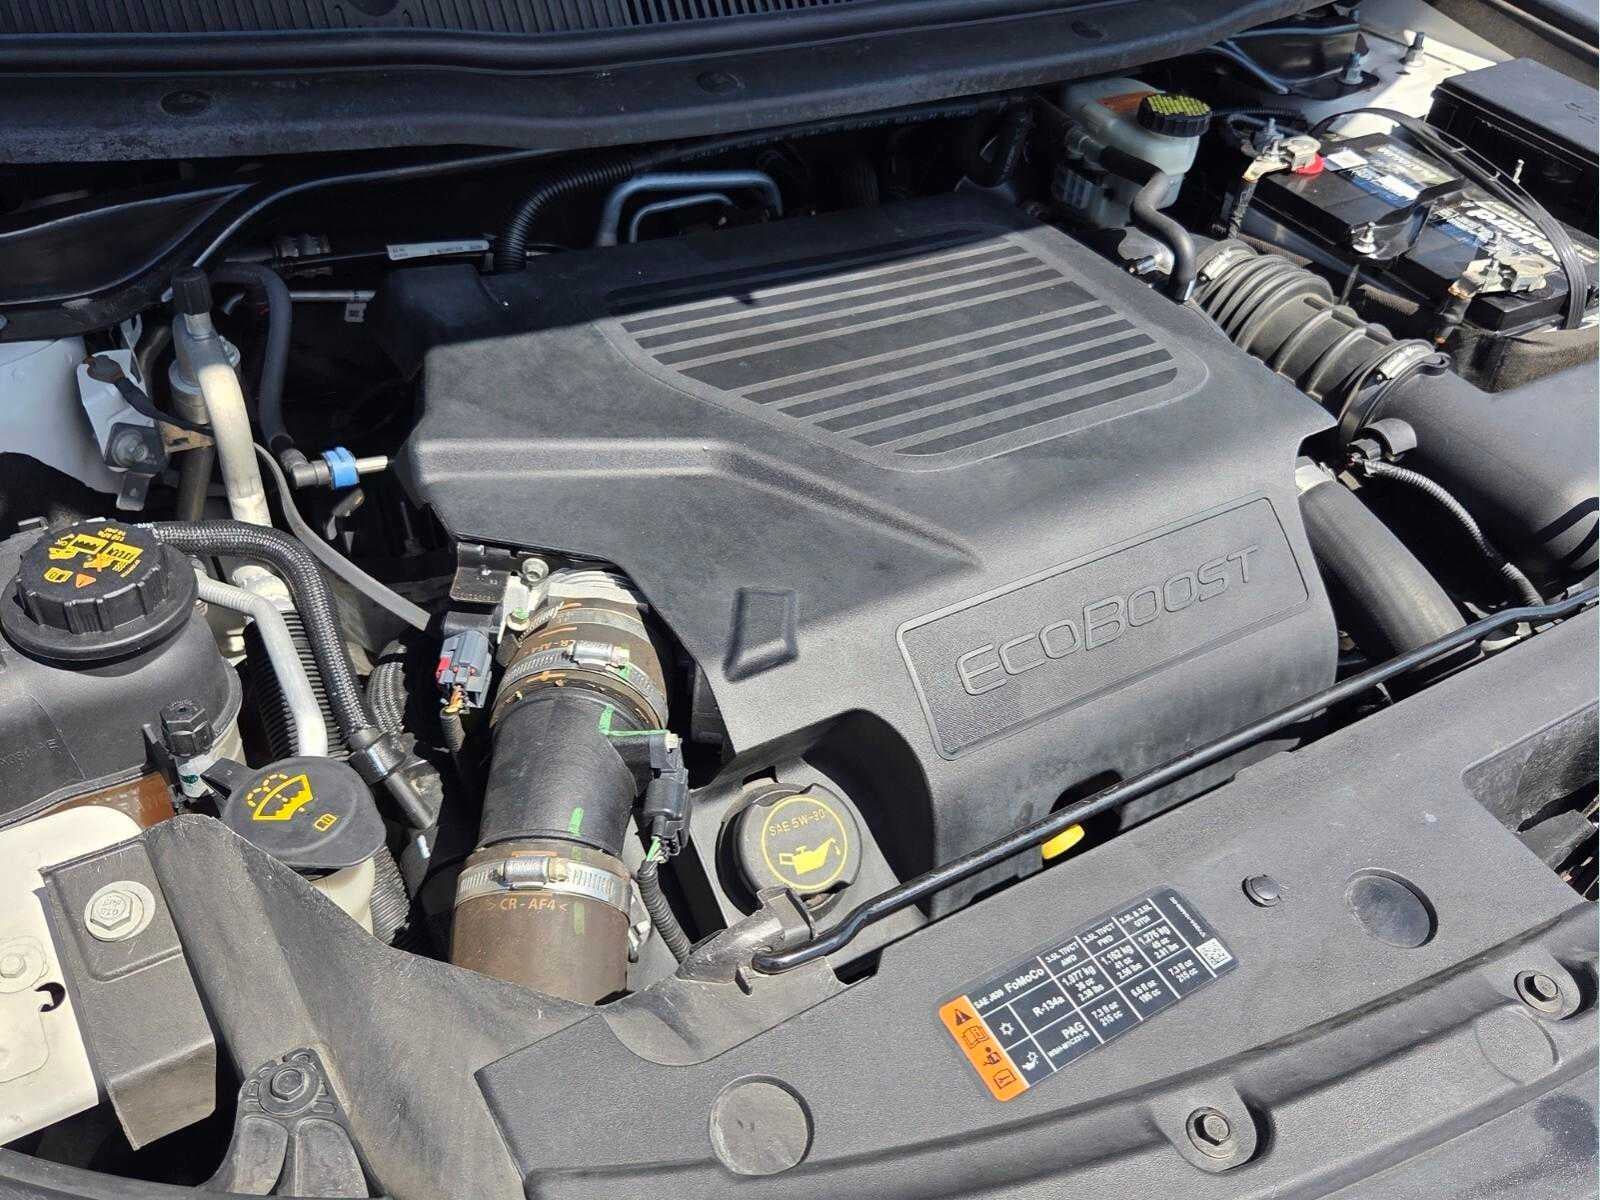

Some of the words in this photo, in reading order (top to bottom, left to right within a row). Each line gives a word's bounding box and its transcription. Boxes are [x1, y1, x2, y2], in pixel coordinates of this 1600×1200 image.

[769, 820, 791, 836] SAE
[791, 808, 825, 829] 5W-30
[1156, 926, 1170, 935] kg
[1097, 935, 1114, 947] FWD
[1119, 945, 1134, 958] kg
[1081, 966, 1096, 976] kg
[973, 997, 990, 1009] SAE
[1004, 969, 1045, 993] FoMoCo
[1091, 984, 1104, 993] lbs
[1032, 996, 1065, 1017] R-134a
[1061, 1022, 1085, 1039] PAG
